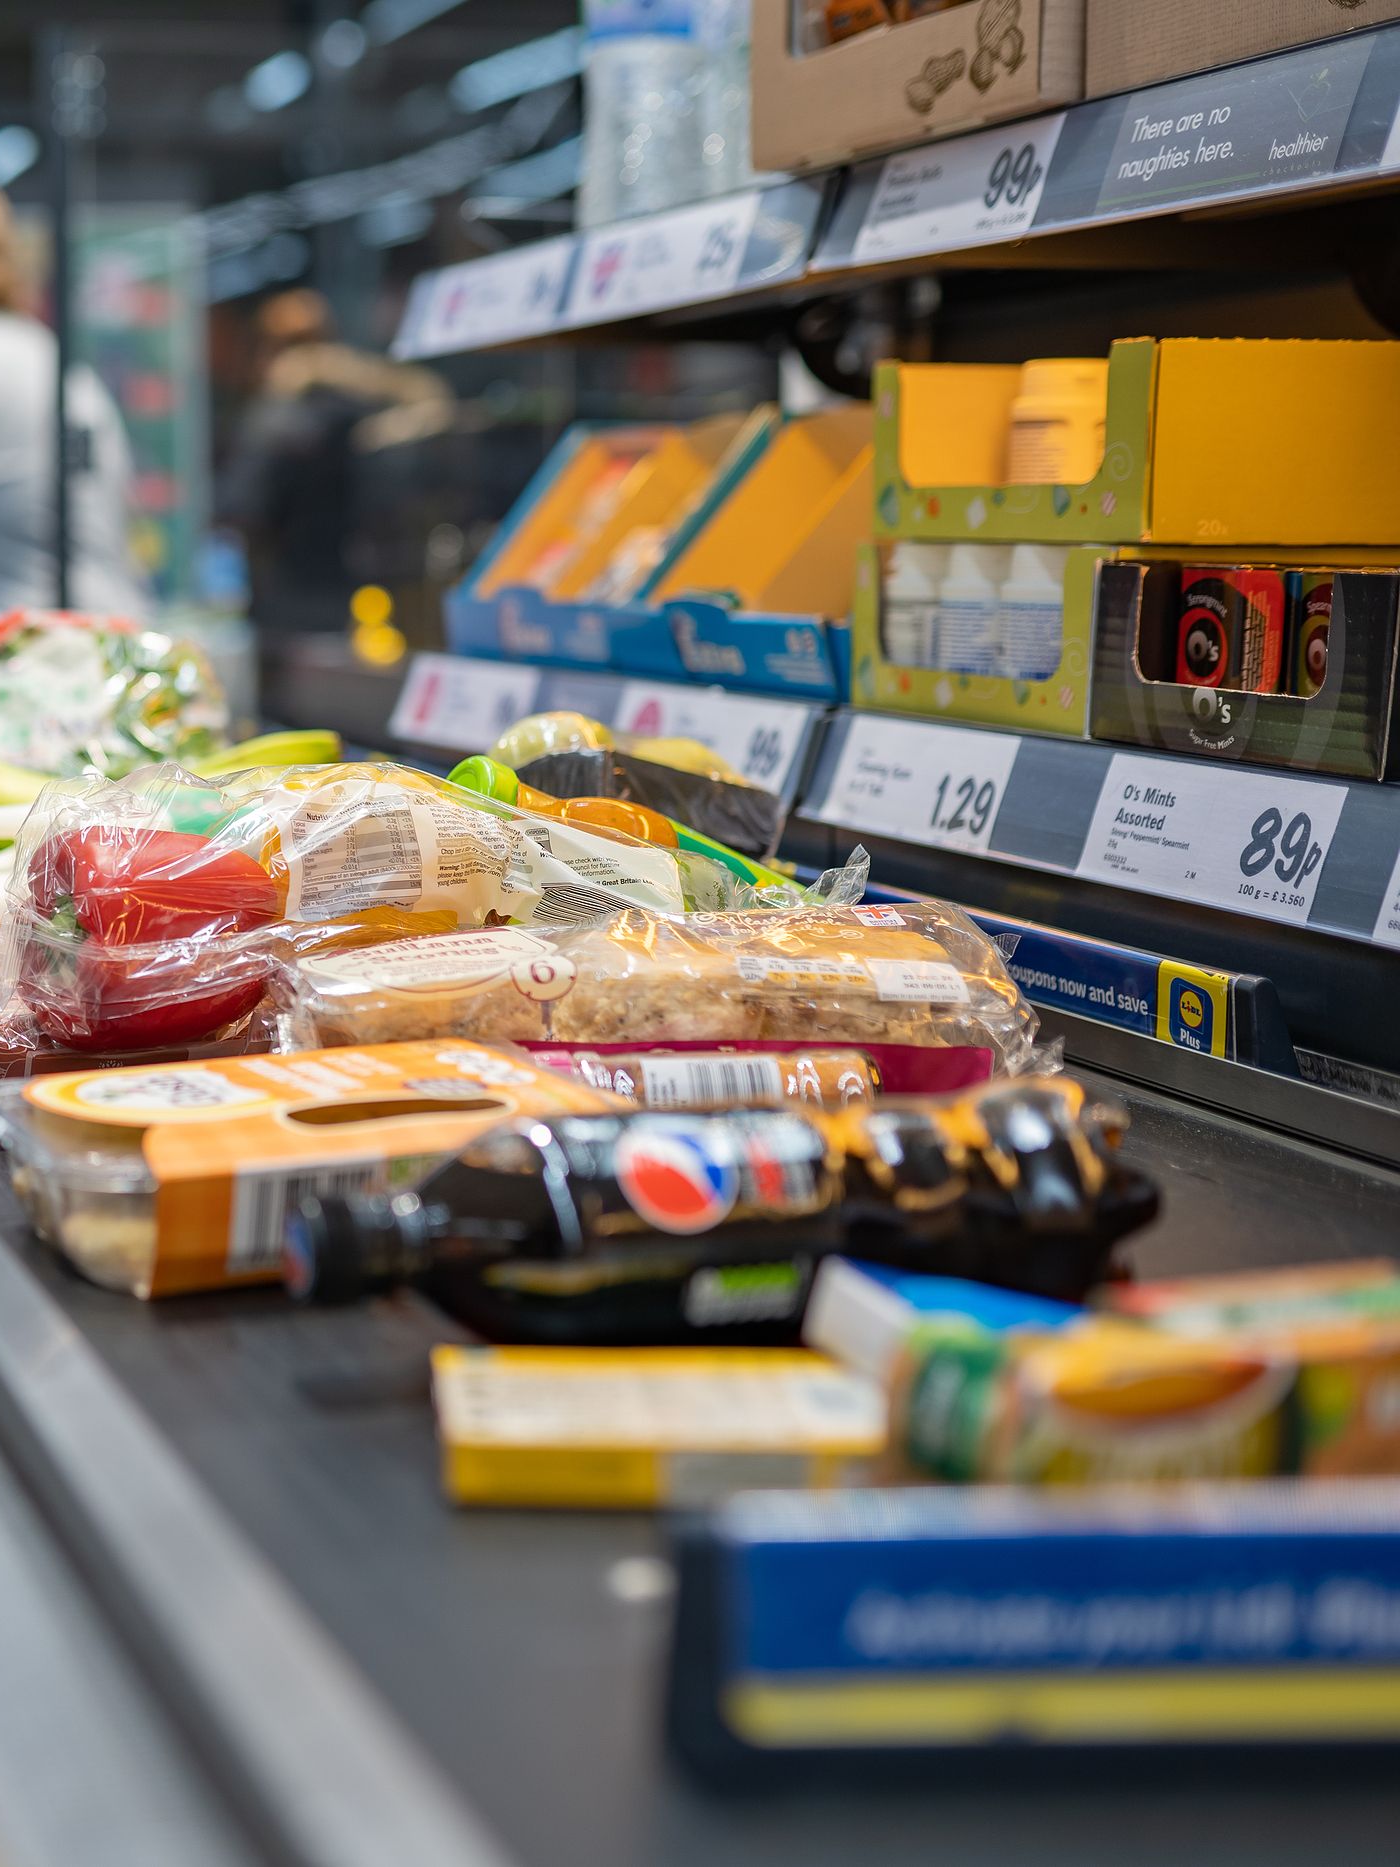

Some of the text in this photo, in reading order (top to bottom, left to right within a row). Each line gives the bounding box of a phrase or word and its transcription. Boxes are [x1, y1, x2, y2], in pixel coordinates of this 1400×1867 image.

[1131, 105, 1231, 143] There are no
[1117, 136, 1235, 181] naughties here.
[1268, 131, 1329, 160] healthier
[983, 143, 1043, 209] 99p
[1192, 687, 1231, 724] O's
[1188, 728, 1236, 750] Sugar Free Mints
[930, 774, 997, 836] 1.29
[1123, 784, 1177, 808] O's Mints
[1114, 807, 1167, 831] Assorted
[1239, 807, 1323, 890] 89p
[601, 879, 620, 887] Great
[1237, 883, 1254, 897] 100
[1254, 889, 1261, 900] g
[1271, 891, 1279, 902] £
[1279, 892, 1305, 908] 3.560
[530, 960, 556, 985] 6
[1007, 964, 1149, 1017] coupons now and save
[1180, 1027, 1201, 1050] Plus
